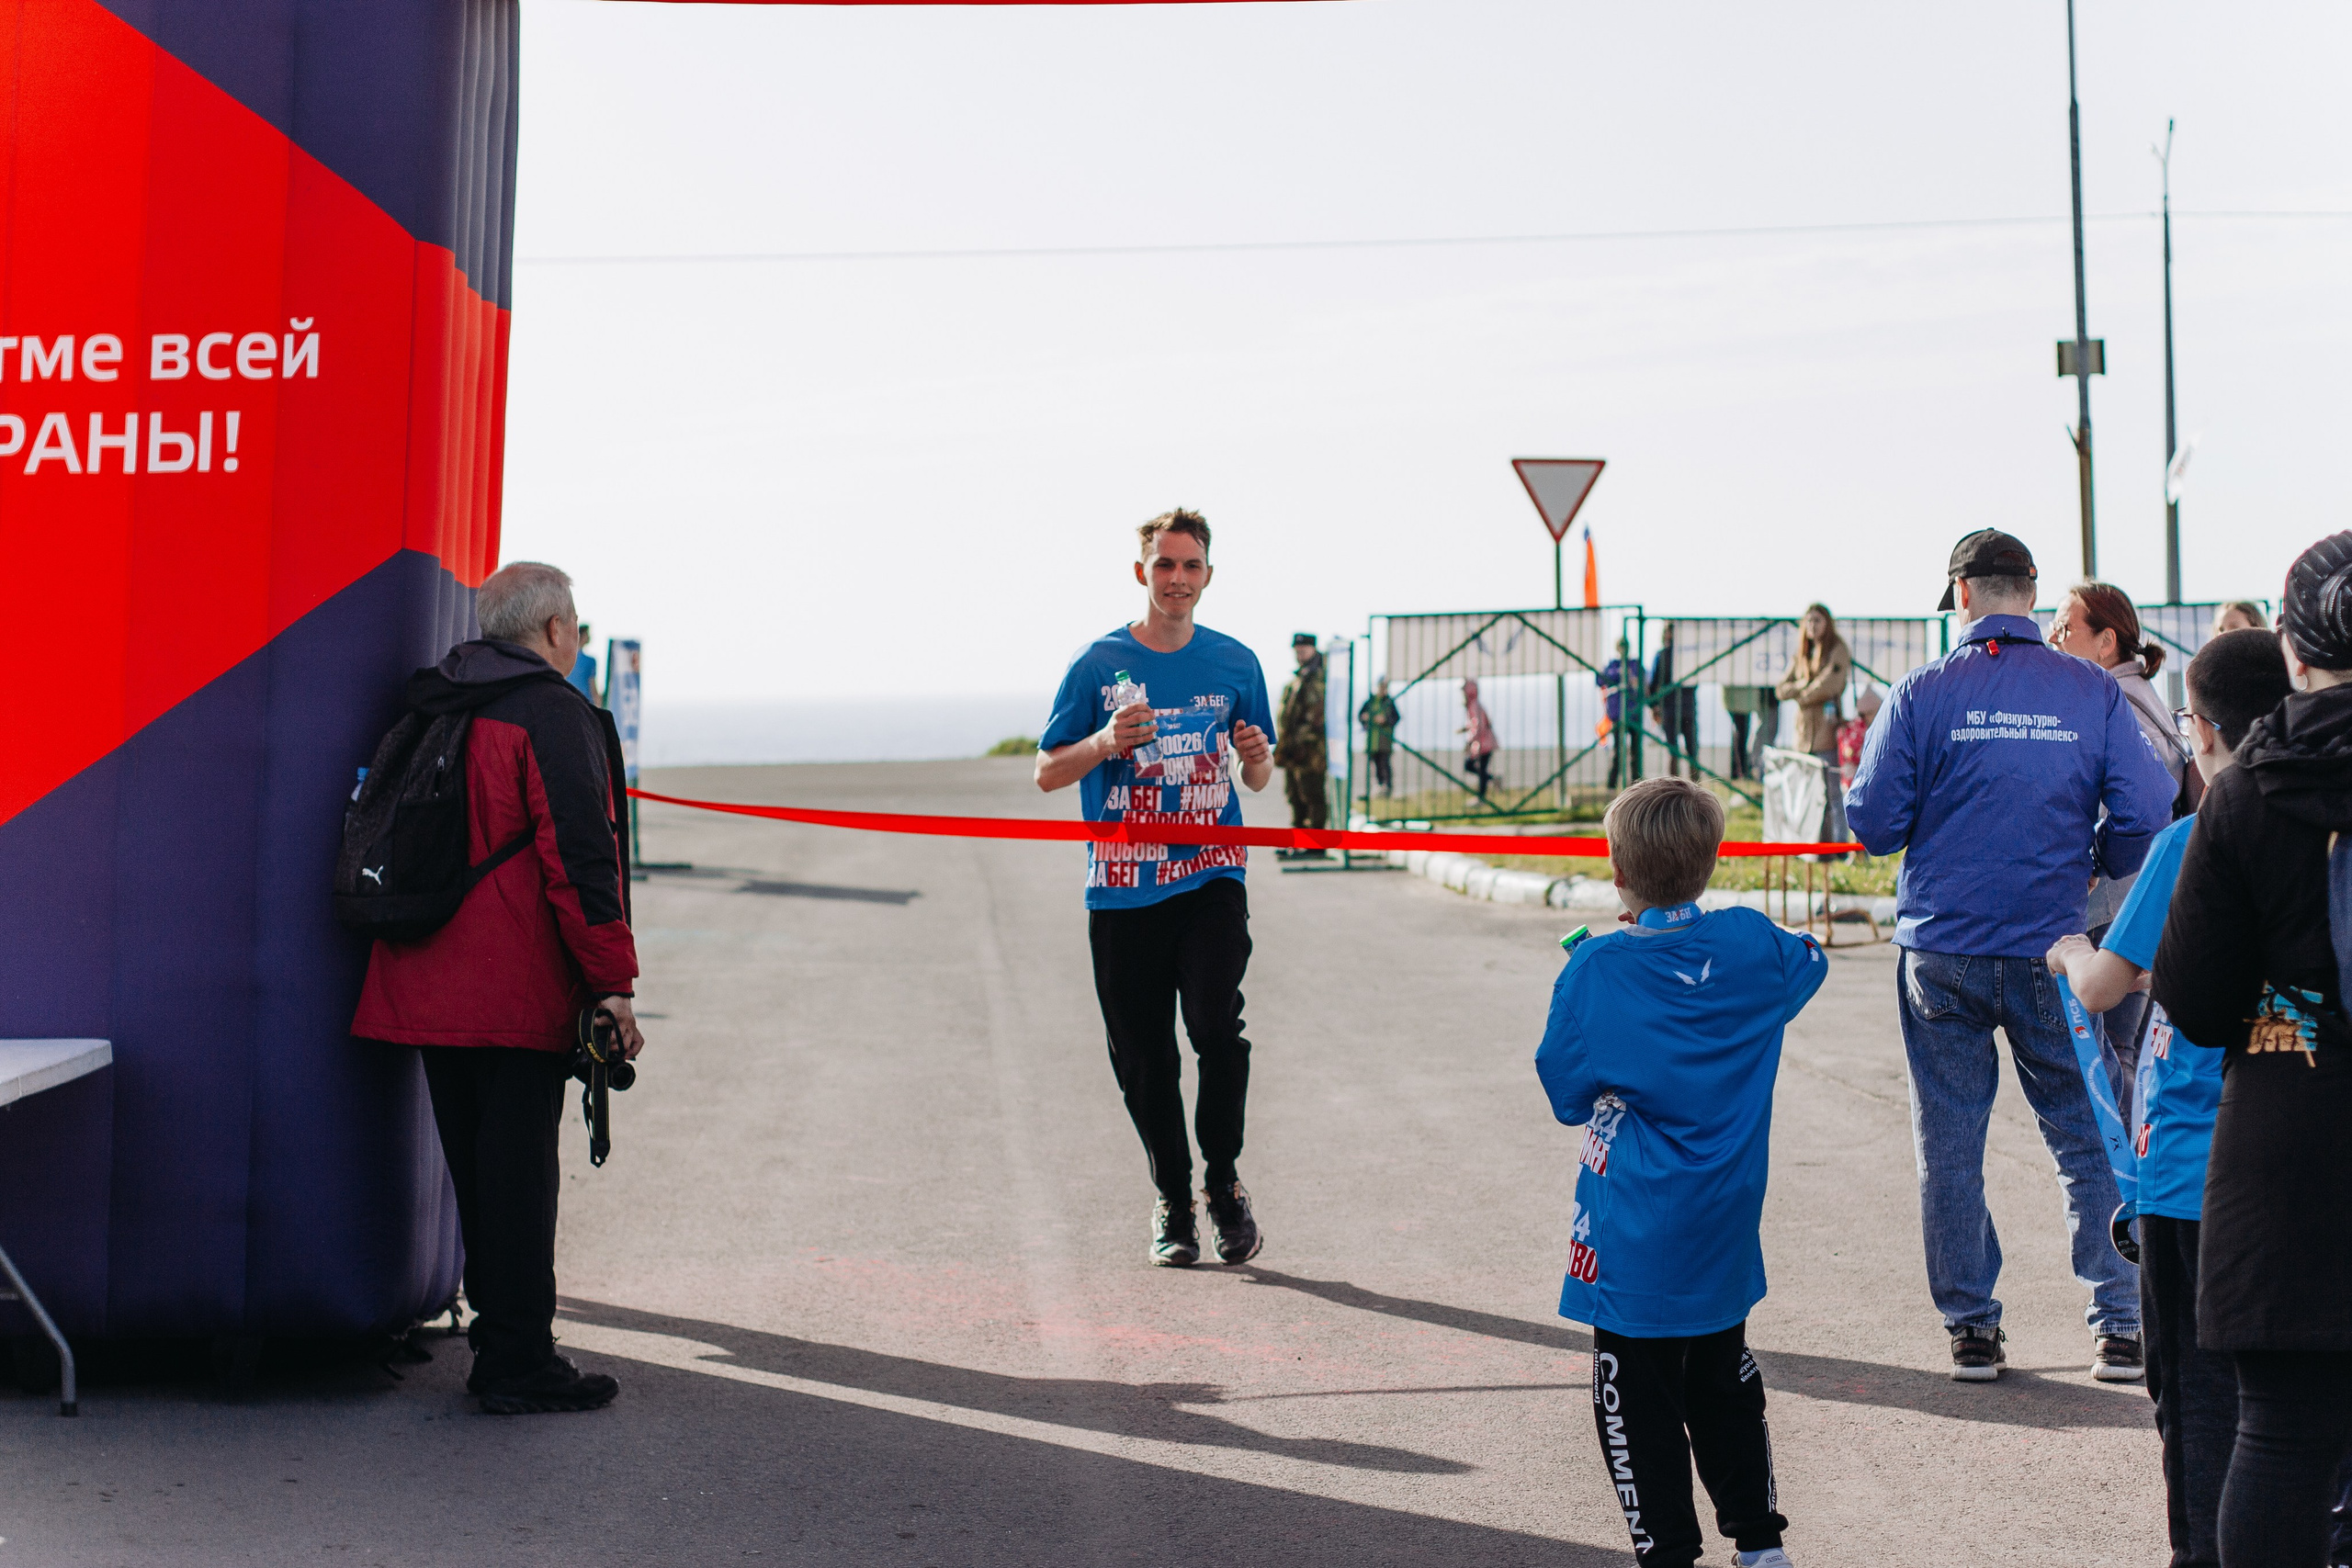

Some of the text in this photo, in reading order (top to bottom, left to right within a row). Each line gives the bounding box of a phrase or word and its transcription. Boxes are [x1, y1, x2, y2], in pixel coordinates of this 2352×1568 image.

[150, 317, 320, 381] всей
[0, 411, 241, 475] РАНЫ!
[1966, 710, 2062, 728] МБУ «Физкультурно-
[1951, 726, 2078, 742] оздоровительный комплекс»
[2068, 998, 2084, 1024] ПСБ
